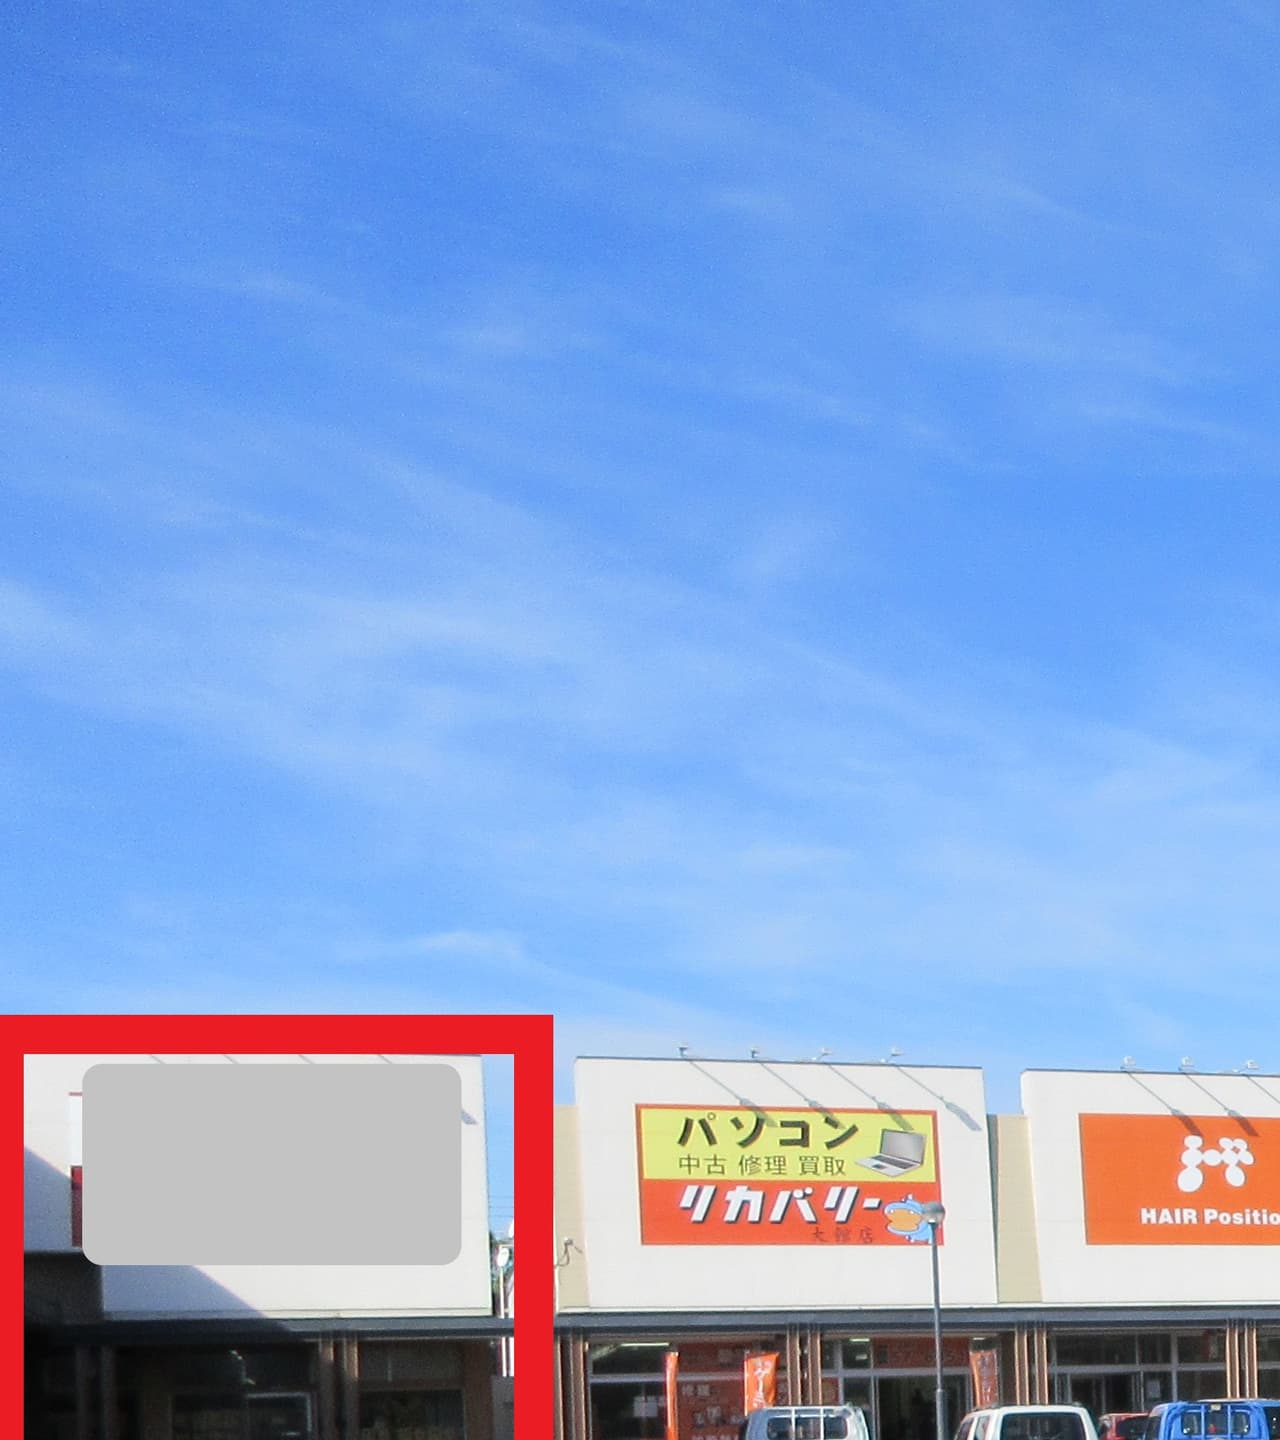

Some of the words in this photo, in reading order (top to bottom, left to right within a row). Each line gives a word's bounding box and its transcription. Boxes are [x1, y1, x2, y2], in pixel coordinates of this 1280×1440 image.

[678, 1112, 859, 1149] パソコン
[678, 1154, 727, 1176] 中古
[739, 1154, 787, 1177] 修理
[799, 1155, 847, 1177] 買取
[679, 1184, 881, 1223] リカバリー
[1140, 1208, 1199, 1225] HAIR
